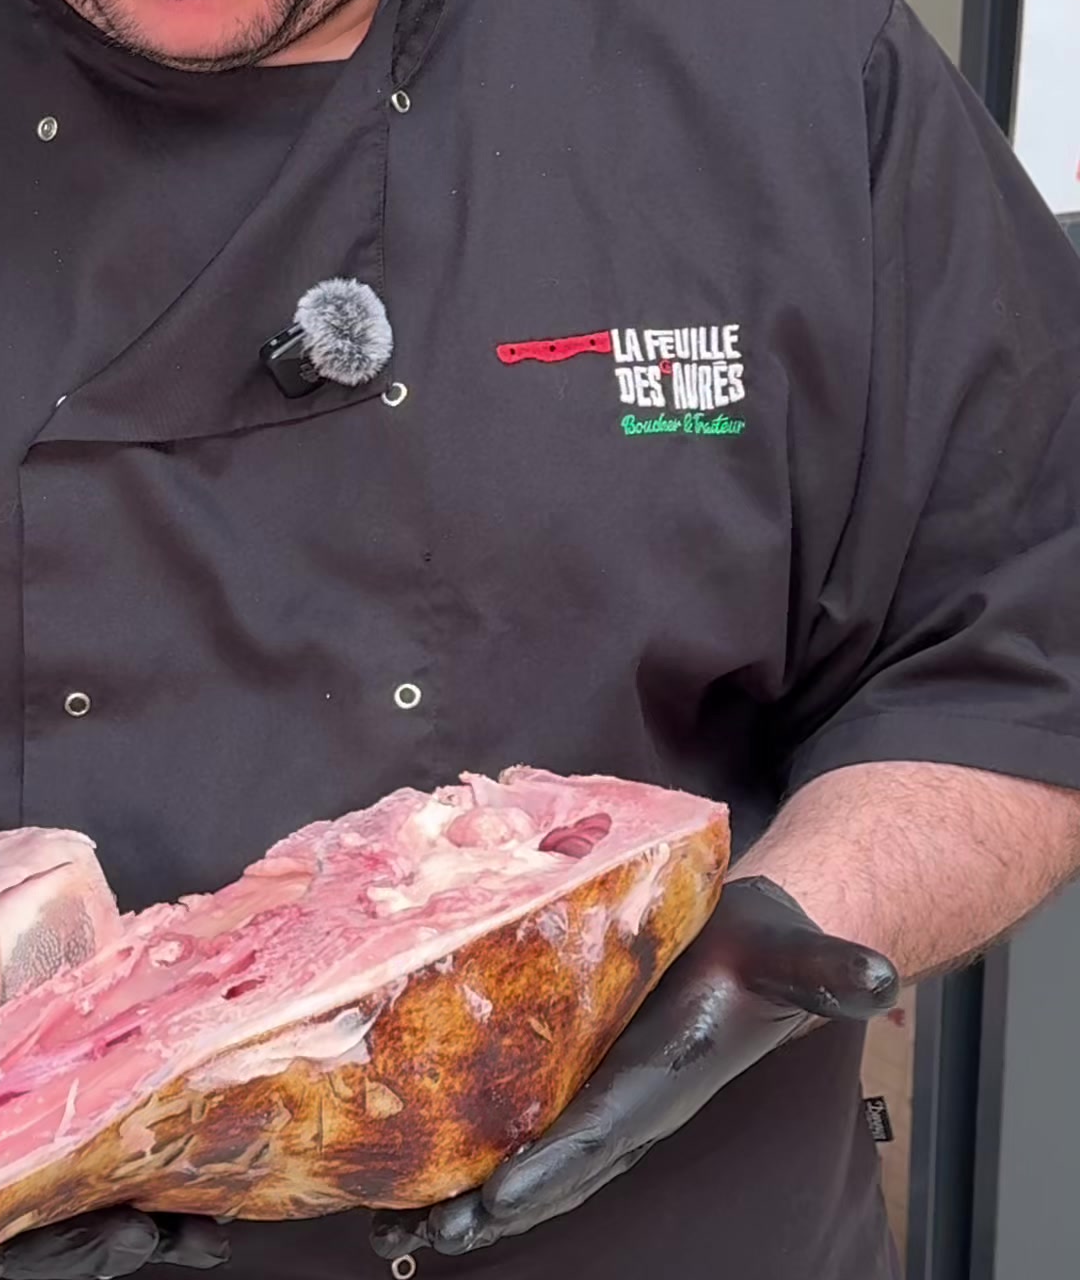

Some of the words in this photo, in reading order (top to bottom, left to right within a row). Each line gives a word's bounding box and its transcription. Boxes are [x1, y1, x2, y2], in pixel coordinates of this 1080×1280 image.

[611, 328, 644, 363] LA
[644, 324, 742, 361] FEUILLE
[615, 365, 666, 408] DES
